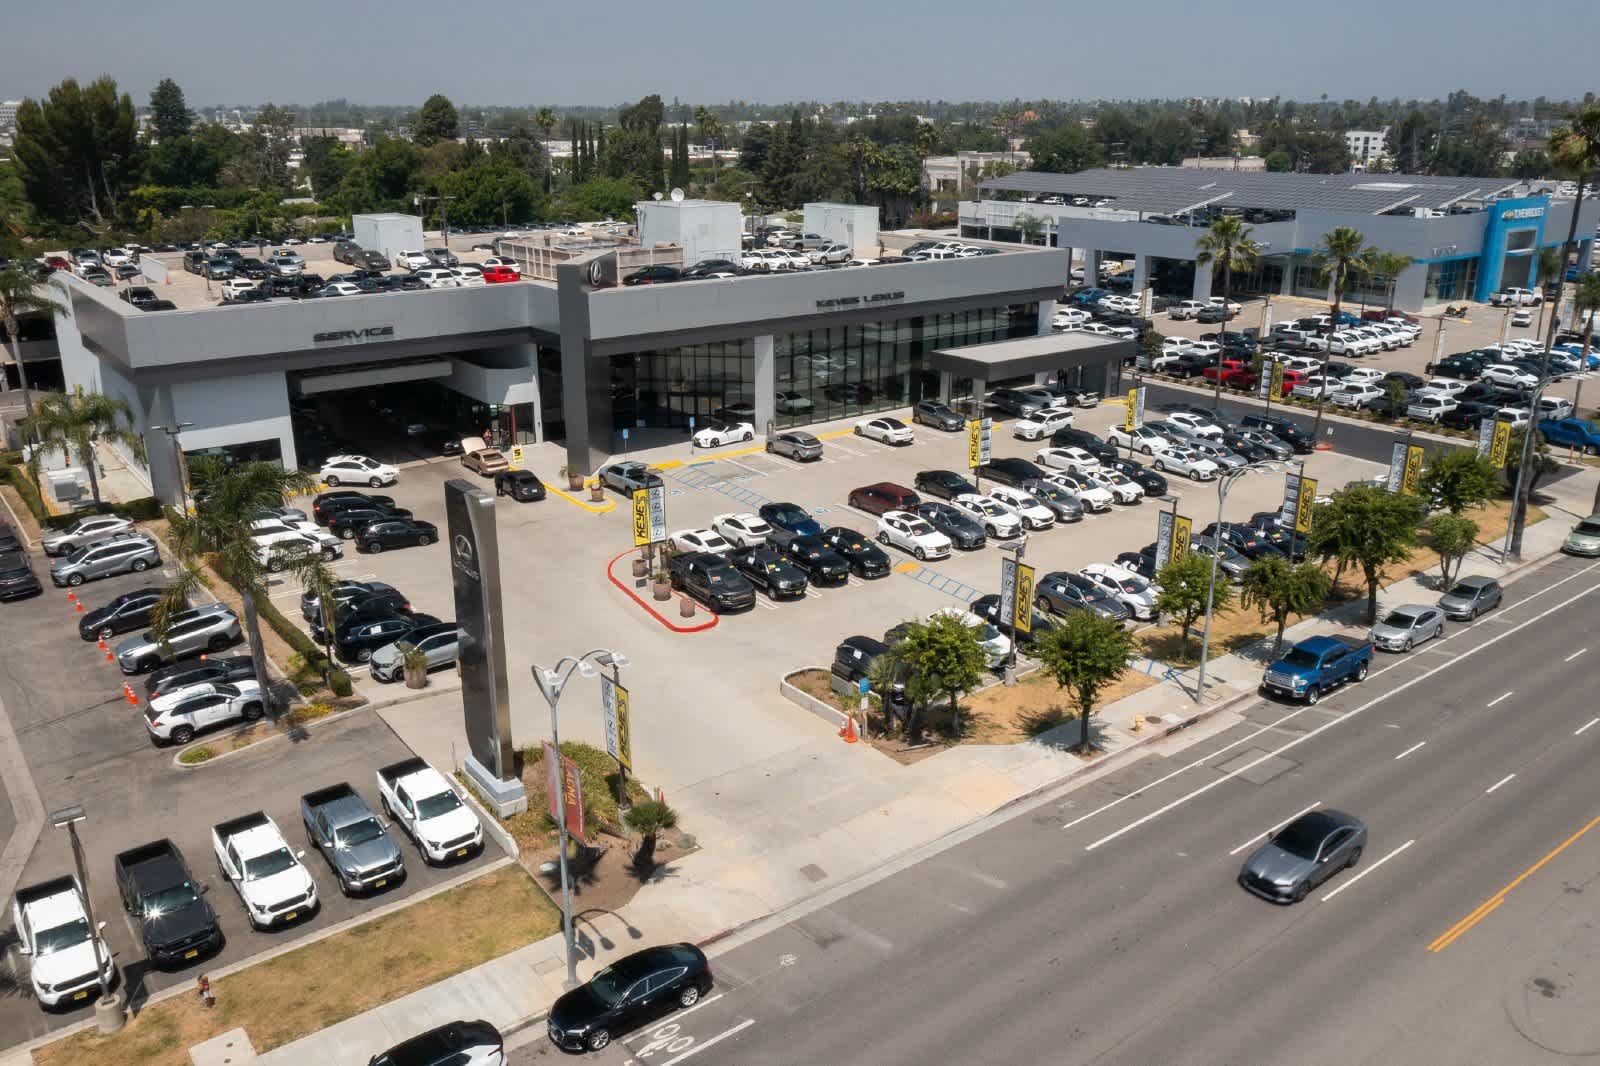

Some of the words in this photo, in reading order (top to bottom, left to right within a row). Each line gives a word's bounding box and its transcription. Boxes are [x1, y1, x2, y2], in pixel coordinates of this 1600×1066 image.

[864, 291, 904, 302] LEXUS
[313, 326, 393, 342] SERVICE
[635, 495, 646, 538] KEYES
[1299, 487, 1313, 527] KEYES
[1018, 576, 1030, 624] KEYES
